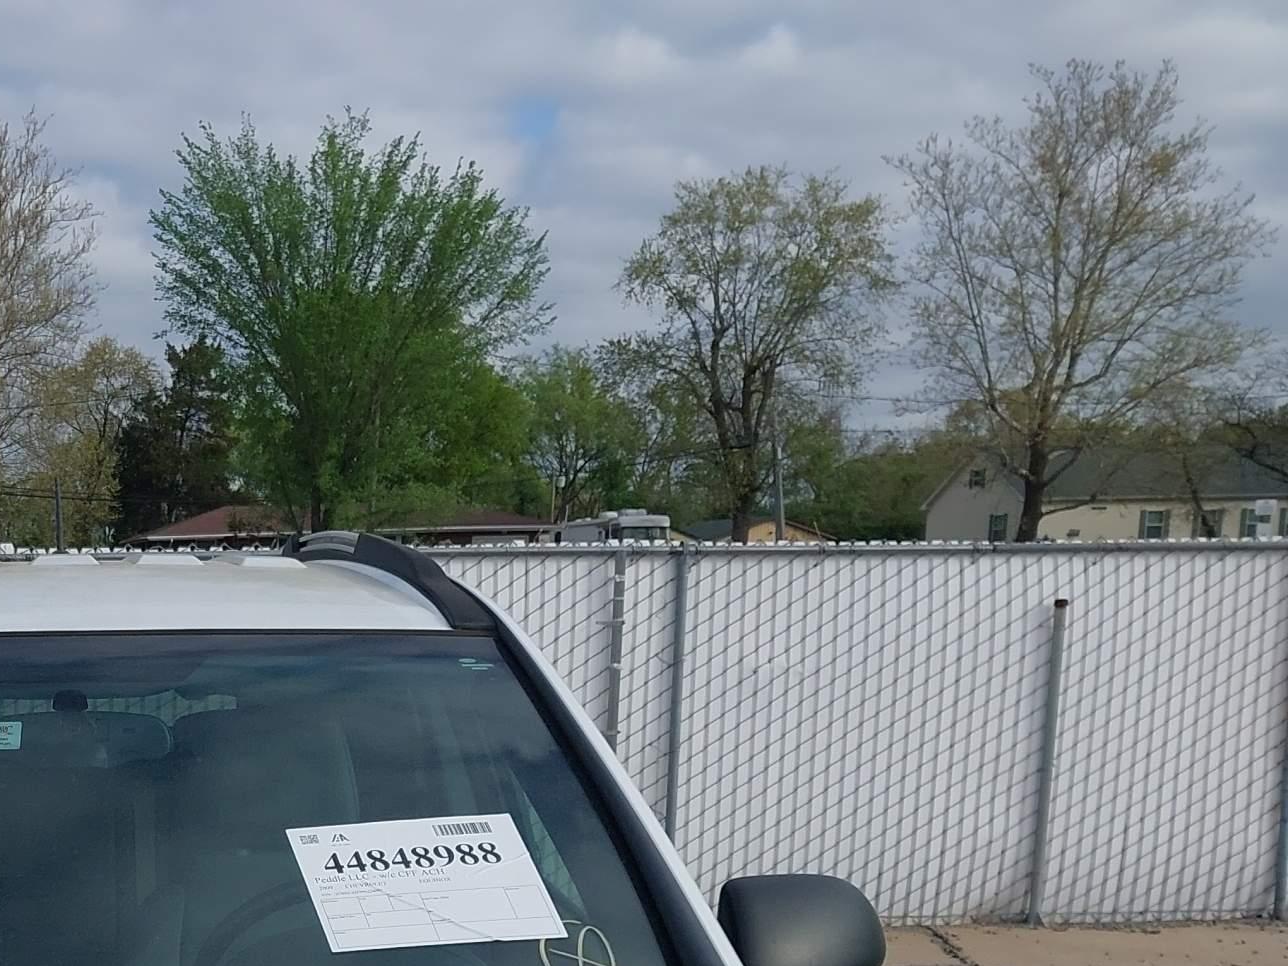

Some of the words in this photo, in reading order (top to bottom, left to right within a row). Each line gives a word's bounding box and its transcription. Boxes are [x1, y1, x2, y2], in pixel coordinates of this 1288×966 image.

[324, 842, 502, 874] 44848988
[314, 875, 345, 884] Peddle
[348, 873, 368, 881] LLC
